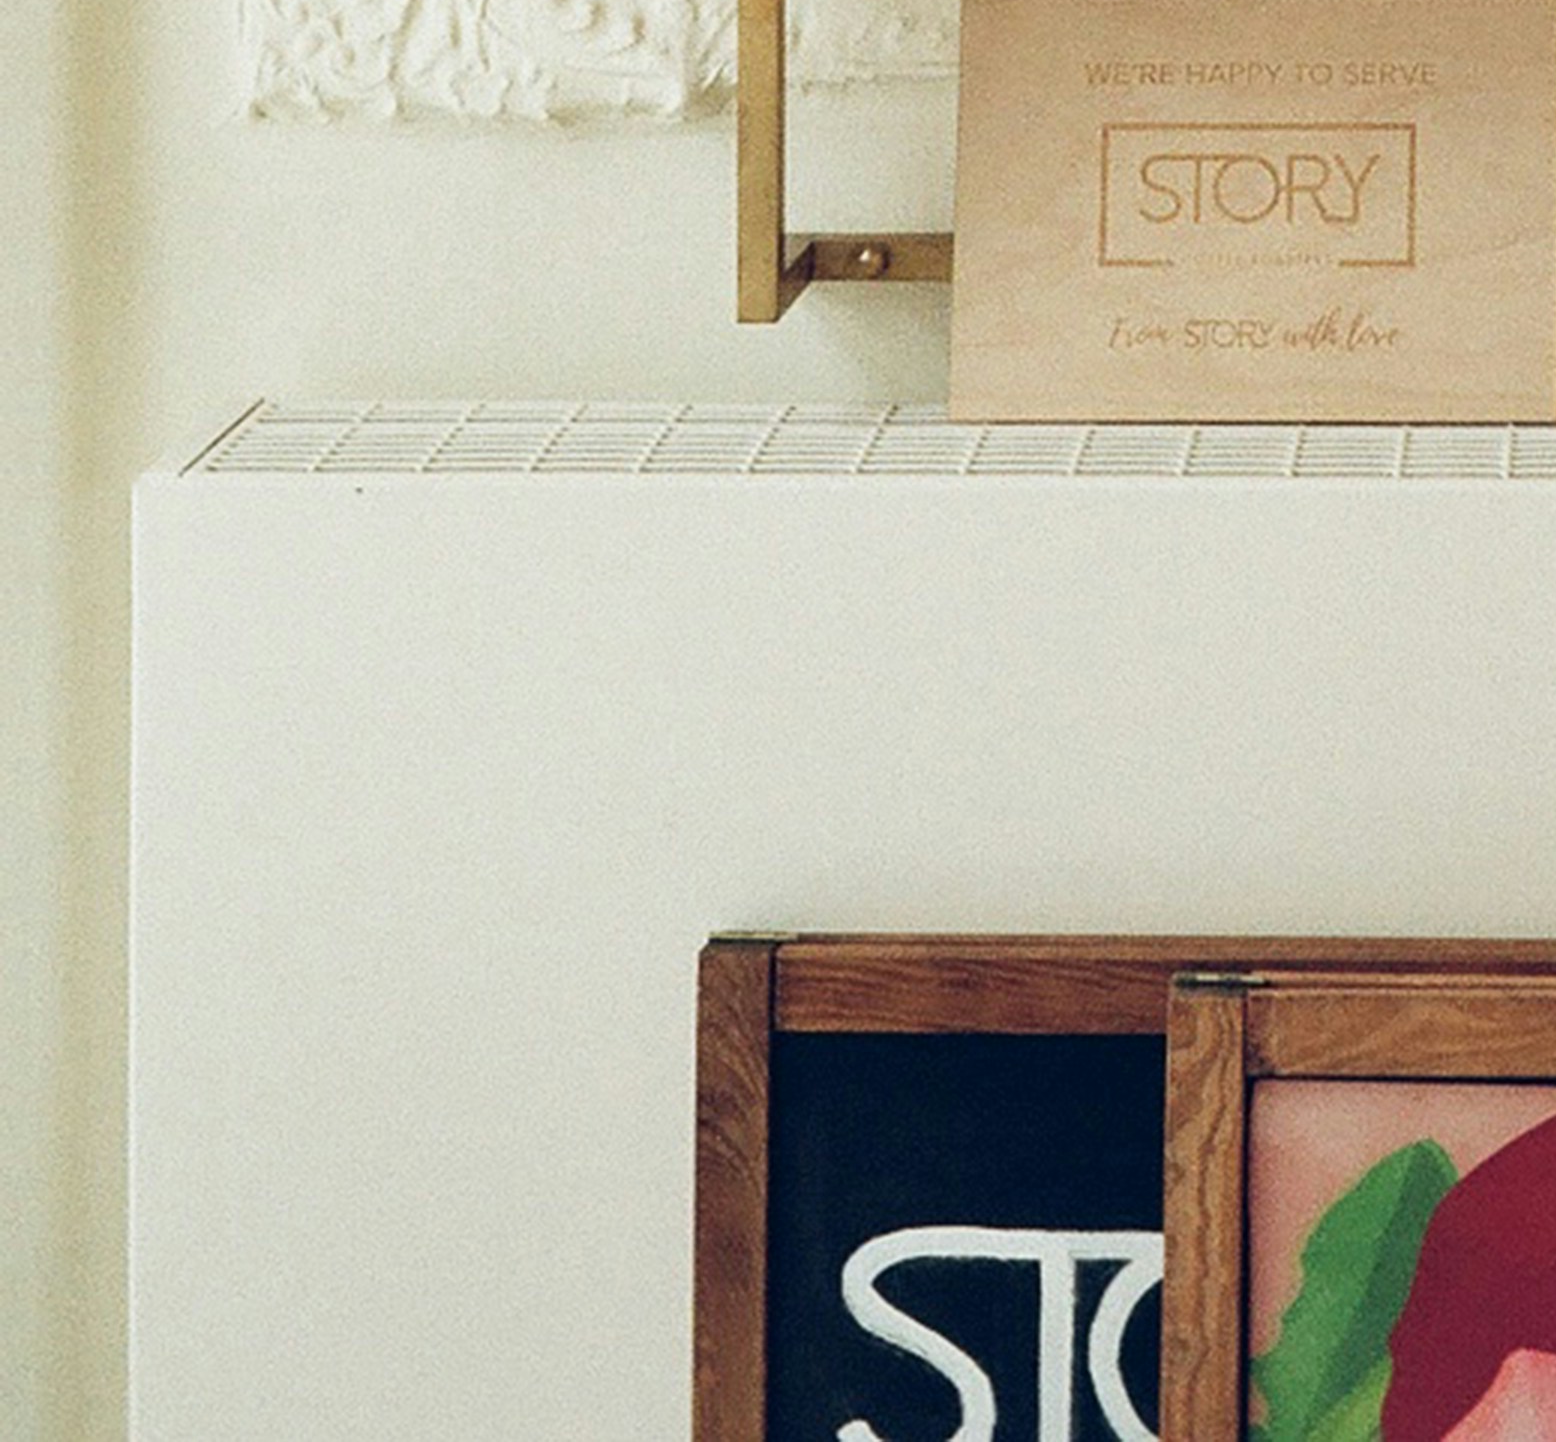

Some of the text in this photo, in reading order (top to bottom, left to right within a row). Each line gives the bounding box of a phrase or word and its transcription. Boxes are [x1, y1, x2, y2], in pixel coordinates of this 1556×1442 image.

[1085, 62, 1438, 86] WE'RE HAPPY TO SERVE
[1138, 153, 1382, 225] STORY
[1183, 318, 1273, 348] STORY
[1281, 304, 1342, 351] with
[1344, 312, 1399, 352] love
[836, 1225, 1165, 1442] ST
